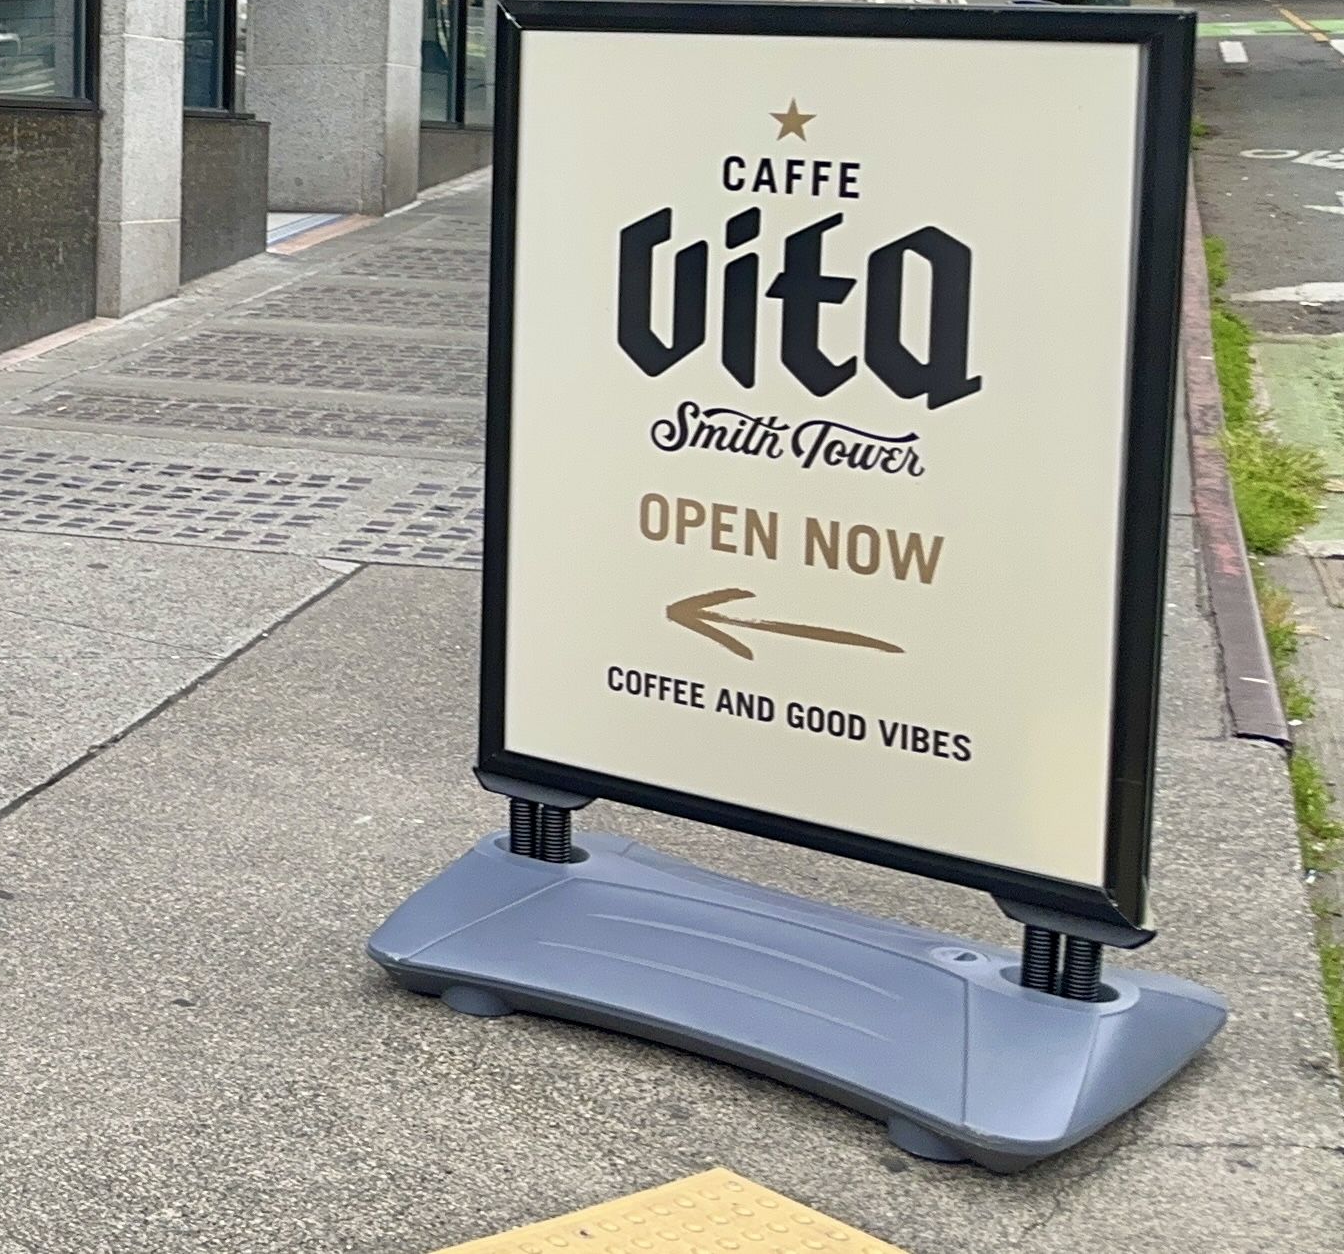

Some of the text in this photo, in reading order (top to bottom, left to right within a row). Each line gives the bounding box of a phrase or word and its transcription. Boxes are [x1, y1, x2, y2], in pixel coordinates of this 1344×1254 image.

[723, 156, 861, 199] CAFFE
[617, 206, 982, 411] vita
[650, 401, 925, 477] Smith Tower
[639, 492, 945, 585] OPEN NOW
[607, 665, 972, 762] COFFEE AND GOOD VIBES
